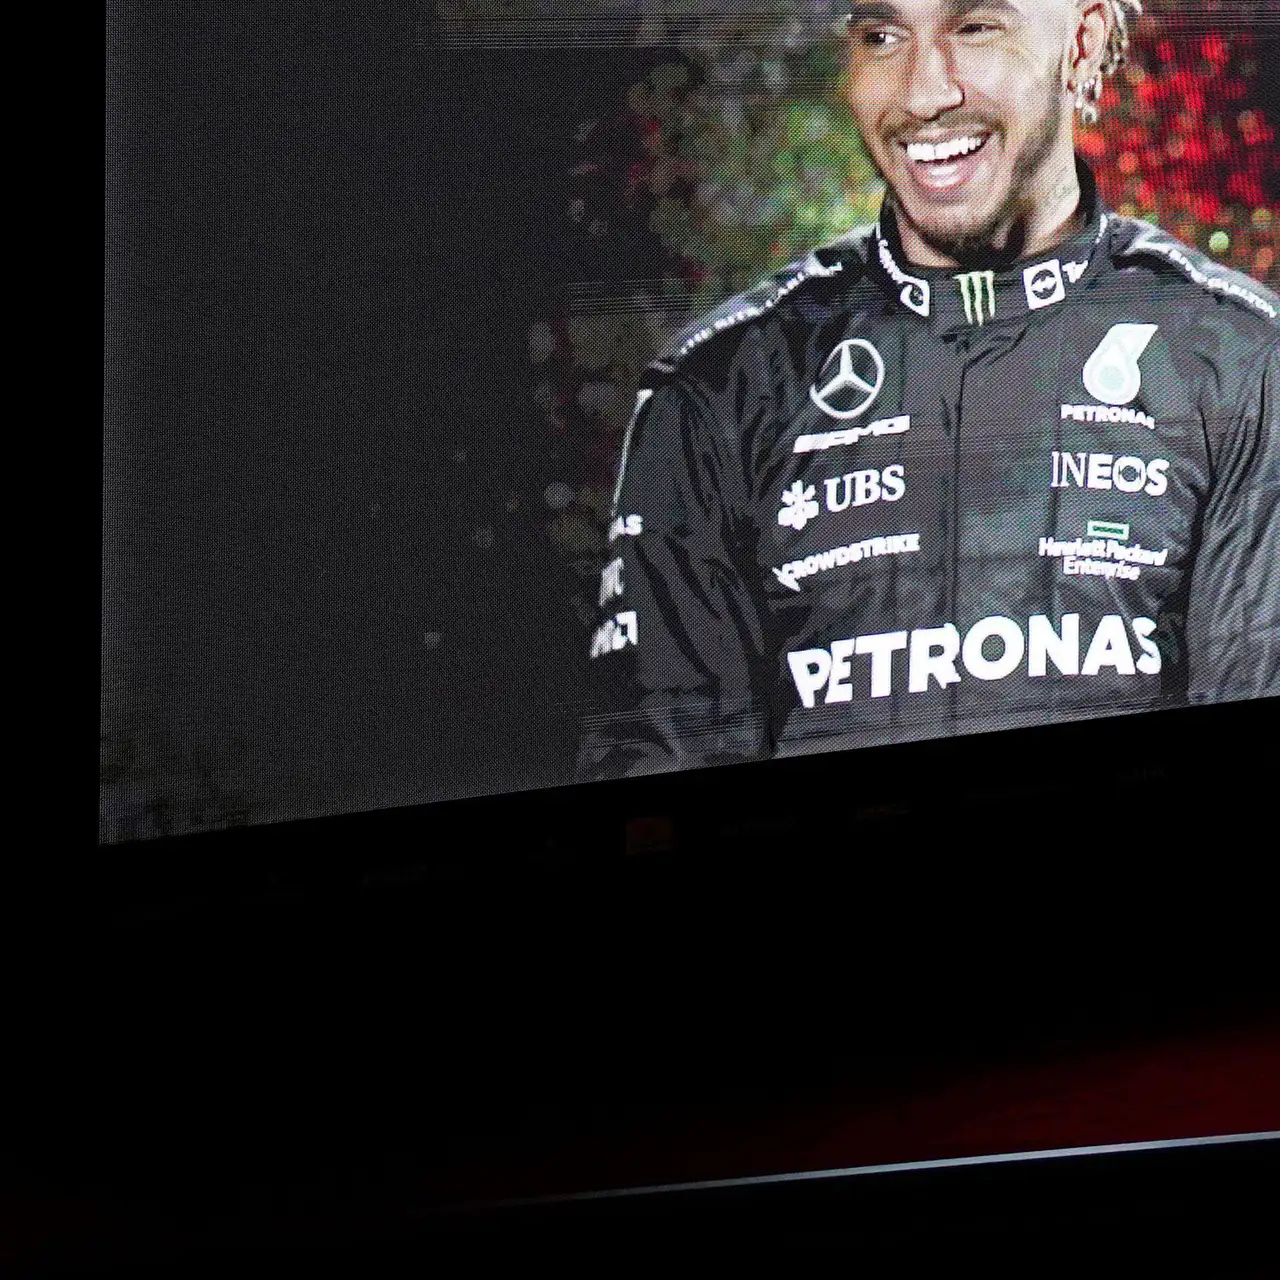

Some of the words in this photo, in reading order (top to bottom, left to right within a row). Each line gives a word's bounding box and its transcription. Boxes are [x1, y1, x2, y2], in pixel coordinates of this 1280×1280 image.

[823, 464, 906, 513] UBS
[1050, 451, 1170, 497] INEOS
[786, 612, 1163, 709] PETRONAS
